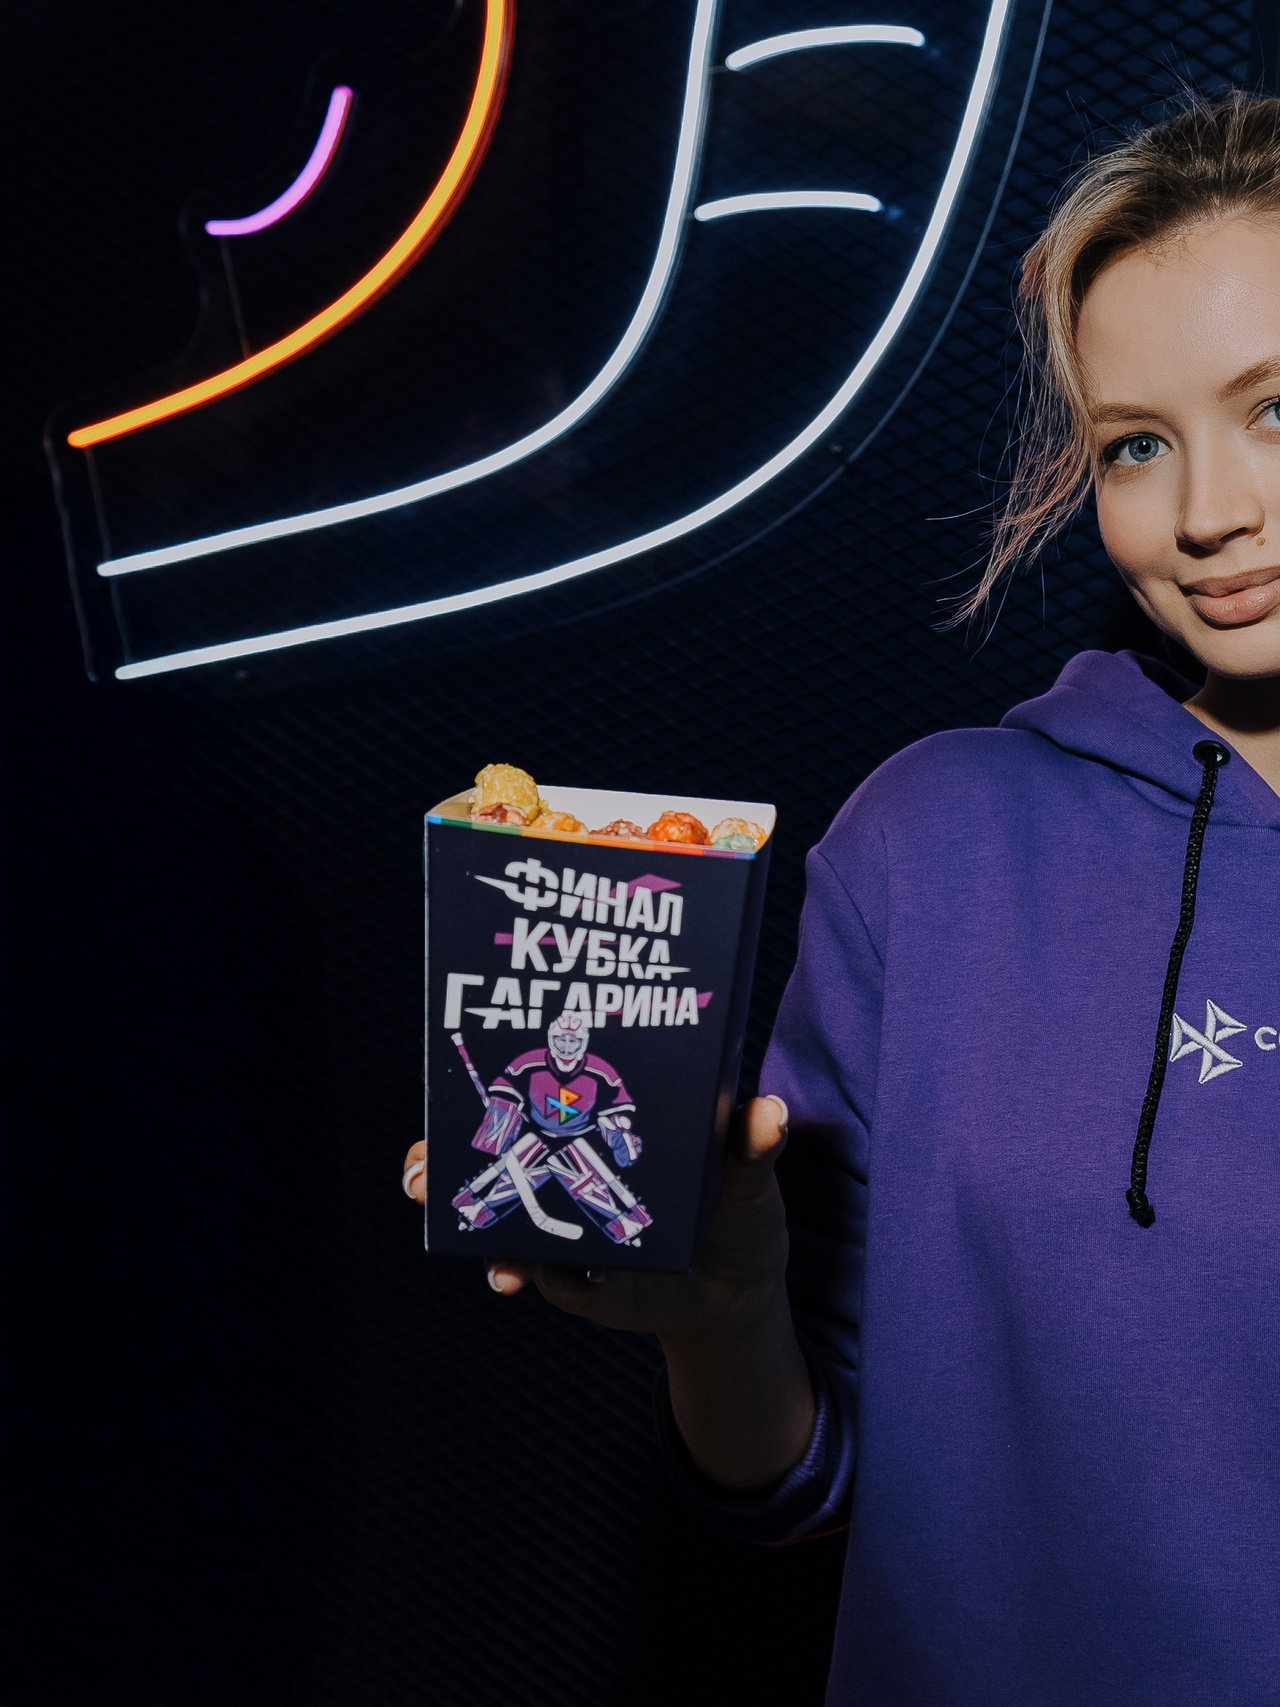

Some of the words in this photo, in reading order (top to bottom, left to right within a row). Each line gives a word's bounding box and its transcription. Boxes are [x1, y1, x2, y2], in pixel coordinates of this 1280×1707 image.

[475, 857, 684, 936] ФИНАЛ
[510, 917, 691, 981] КУБКА
[443, 973, 699, 1029] ГАГАРИНА
